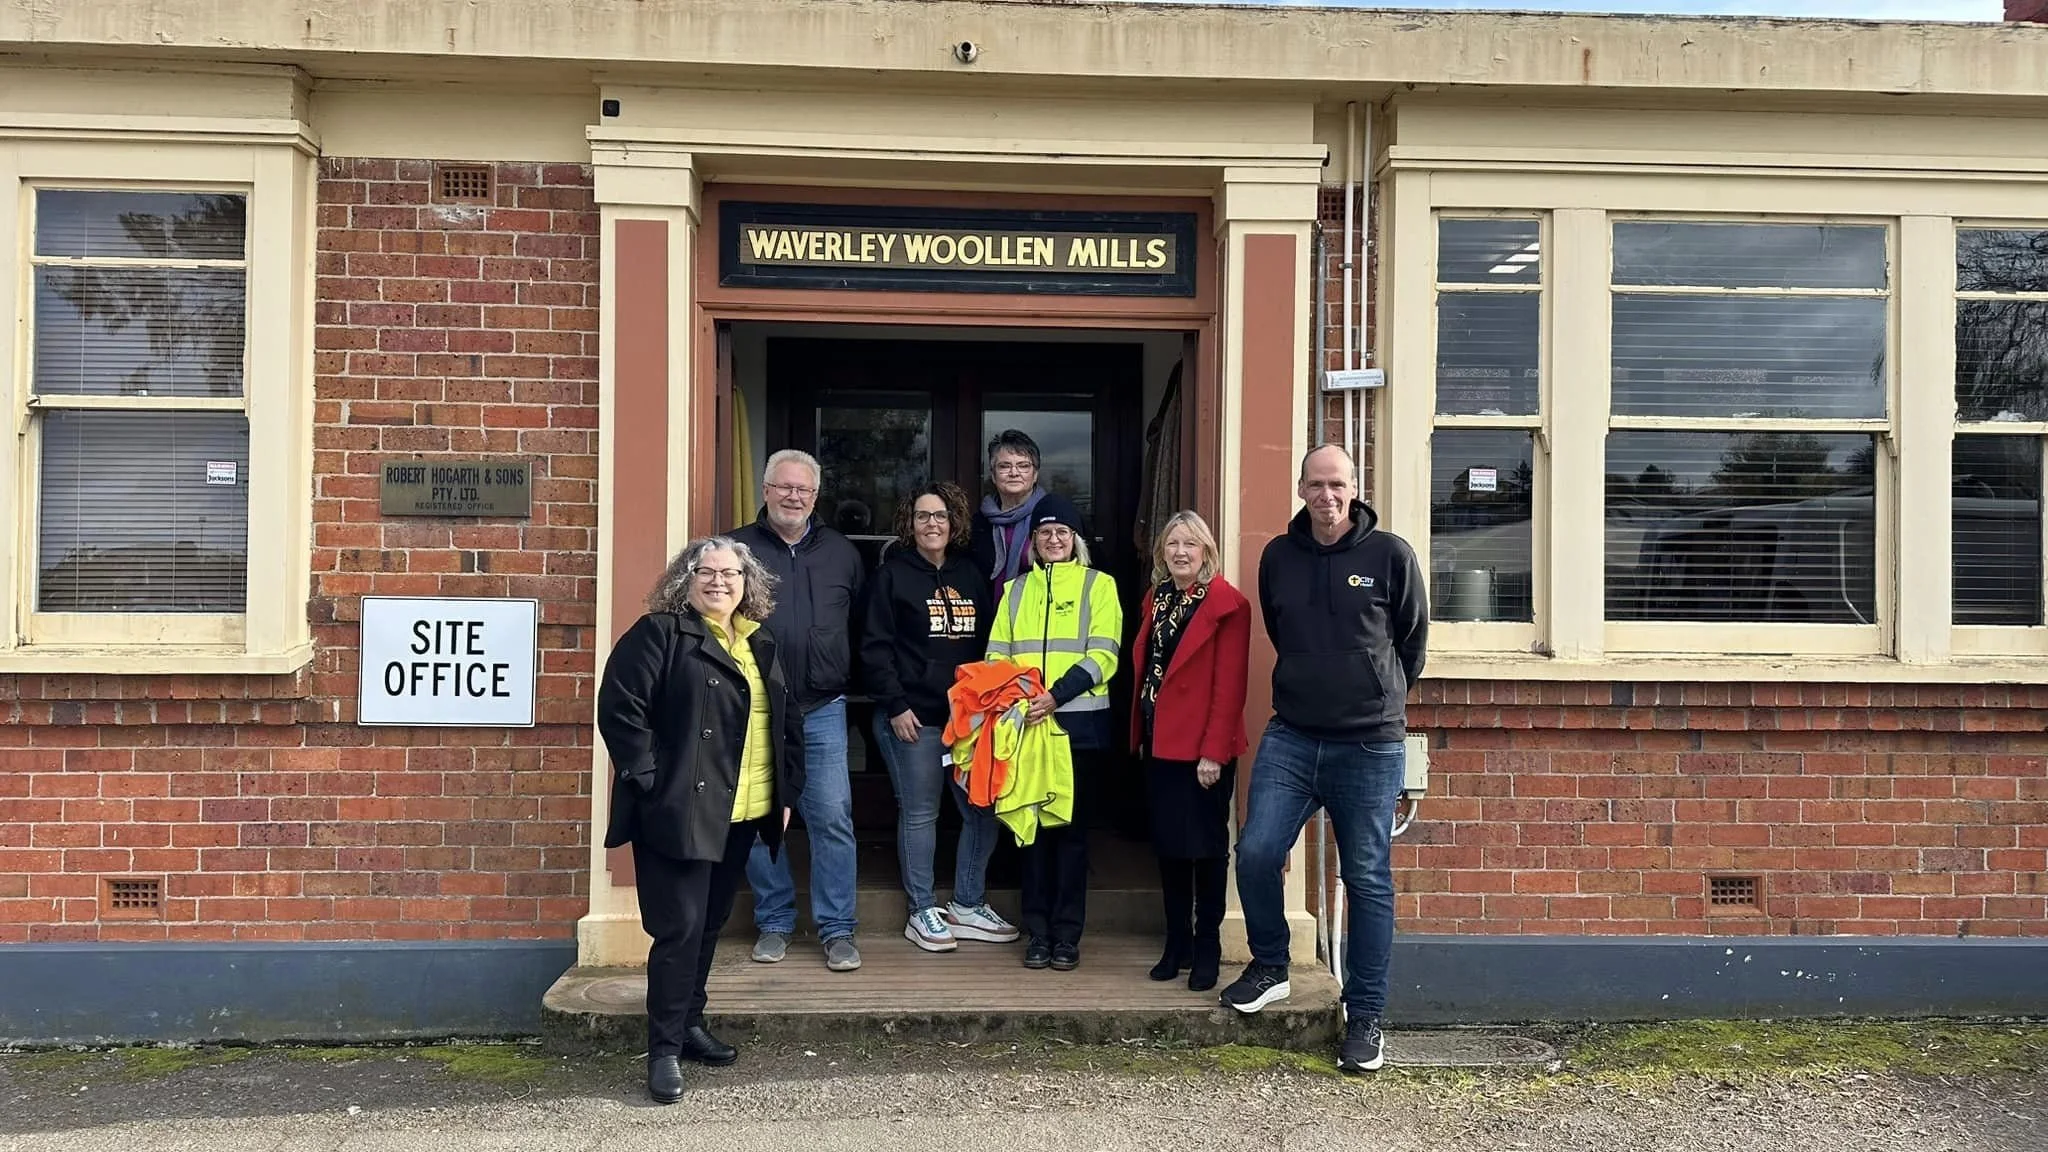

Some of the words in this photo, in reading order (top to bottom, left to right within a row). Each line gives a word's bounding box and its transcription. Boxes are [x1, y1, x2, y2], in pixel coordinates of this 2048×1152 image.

[747, 229, 897, 263] WAVERLEY
[903, 233, 1054, 266] WOOLLEN
[1067, 237, 1167, 269] MILLS
[386, 466, 426, 484] ROBERT
[431, 467, 480, 485] HOGARTH
[484, 468, 492, 485] &
[495, 468, 524, 486] SONS
[415, 502, 463, 510] REGISTERED
[467, 502, 495, 510] OFFICE
[410, 620, 485, 655] SITE
[384, 661, 510, 698] OFFICE
